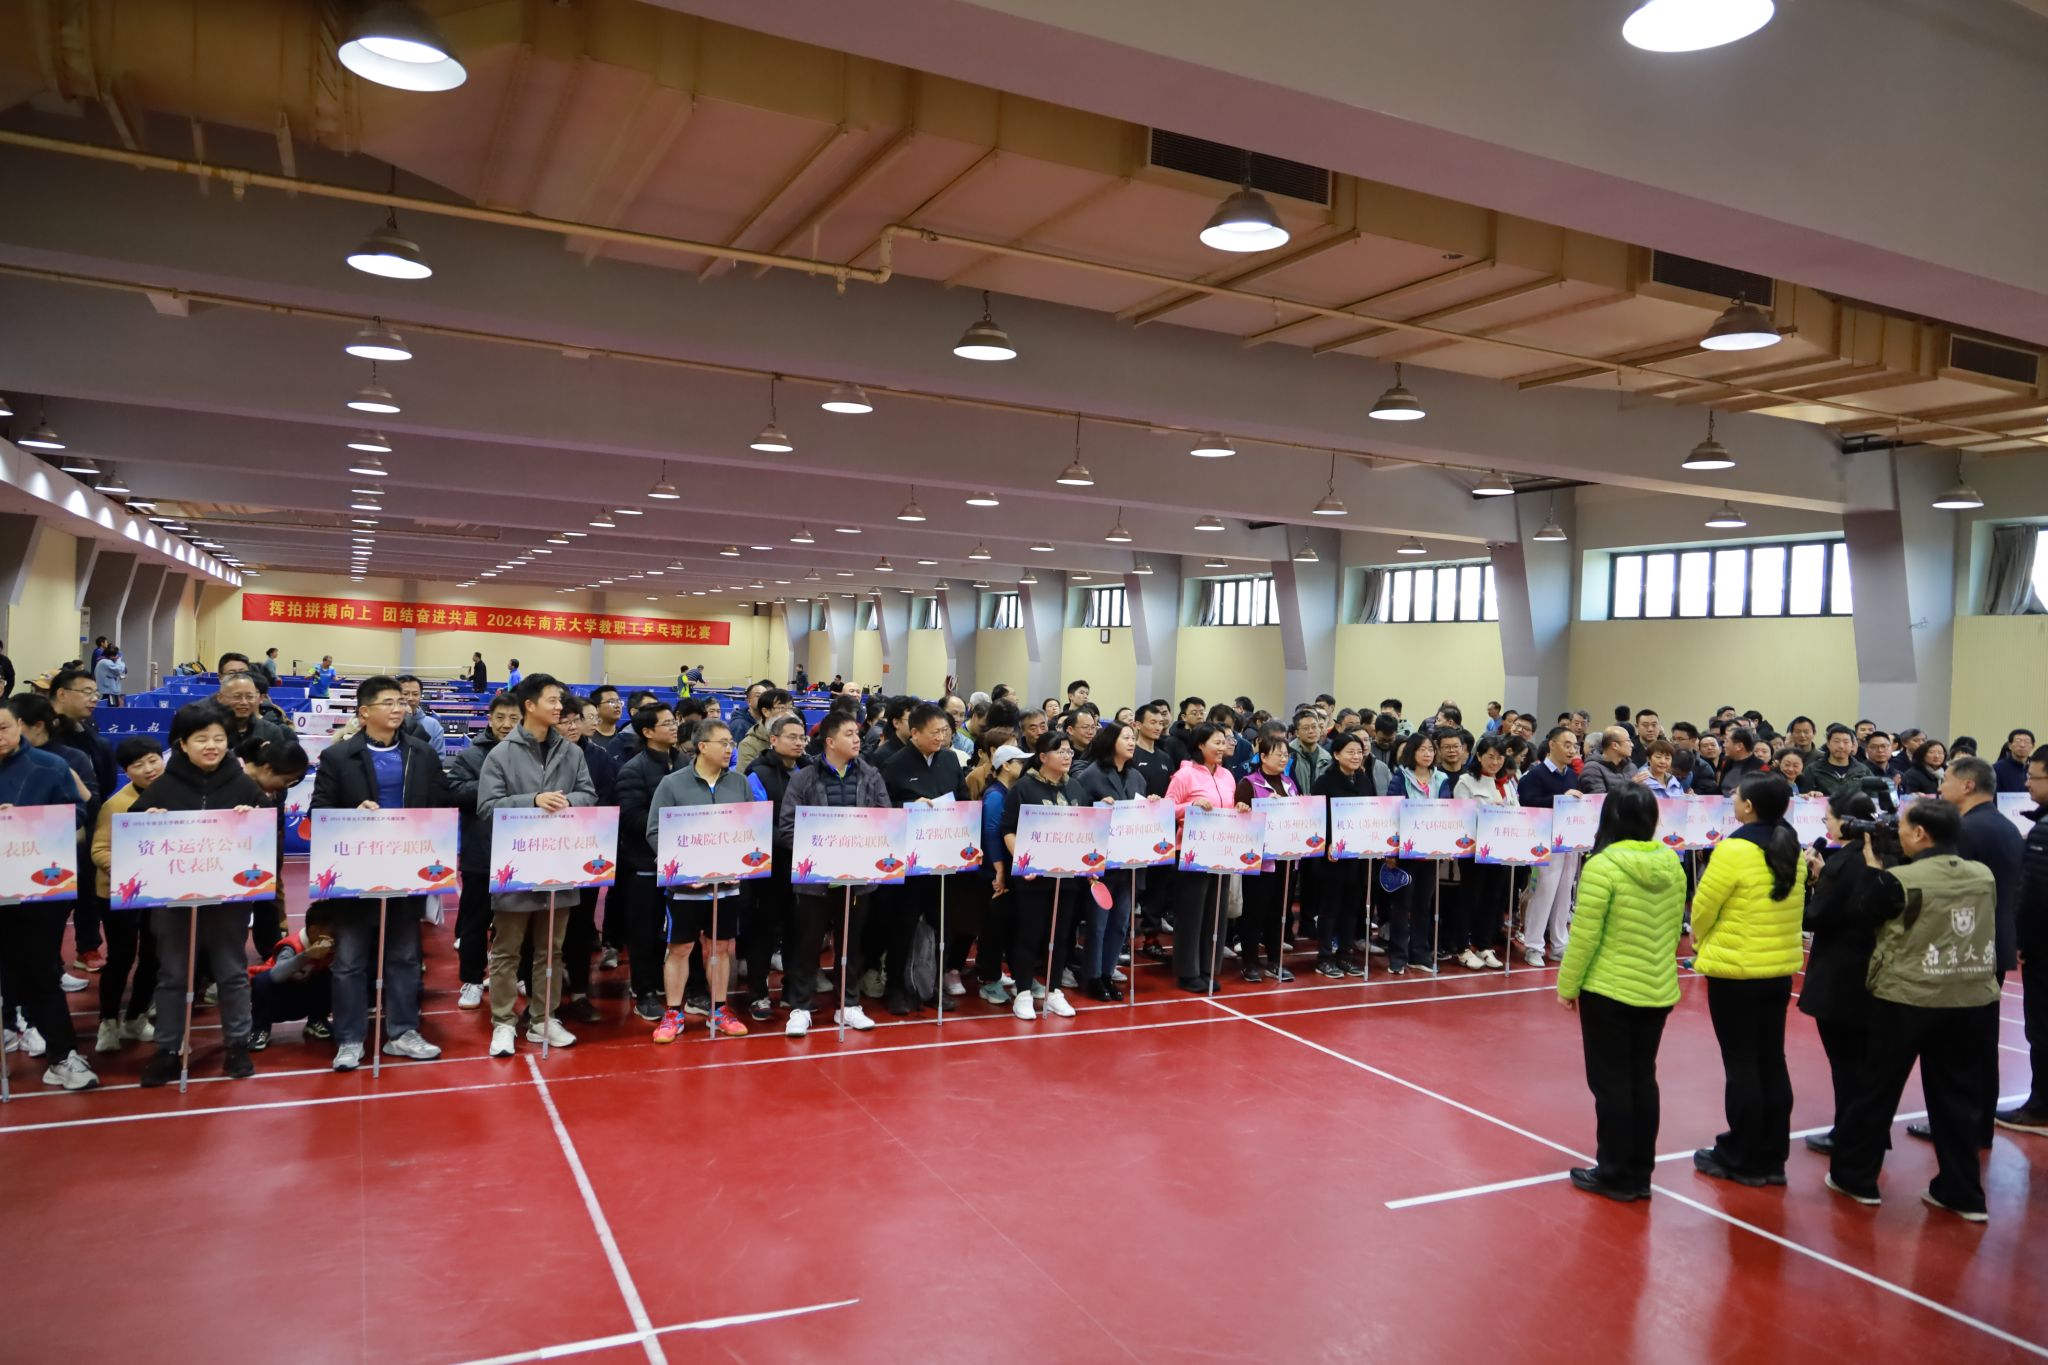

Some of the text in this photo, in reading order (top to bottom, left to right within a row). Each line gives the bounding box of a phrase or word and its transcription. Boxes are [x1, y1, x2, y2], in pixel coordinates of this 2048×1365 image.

[269, 600, 711, 640] 挥拍拼搏向上 团结奋进共赢 2024年南京大学教职工乒乓球比赛
[677, 829, 756, 848] 建城院代表队
[811, 834, 890, 849] 数学商院联队
[915, 826, 970, 840] 法学院代表队
[1030, 830, 1095, 844] 现工院代表队
[137, 835, 253, 856] 资本运营公司
[334, 839, 436, 856] 电子哲学联队
[512, 835, 599, 852] 地科院代表队
[169, 857, 224, 875] 代表队
